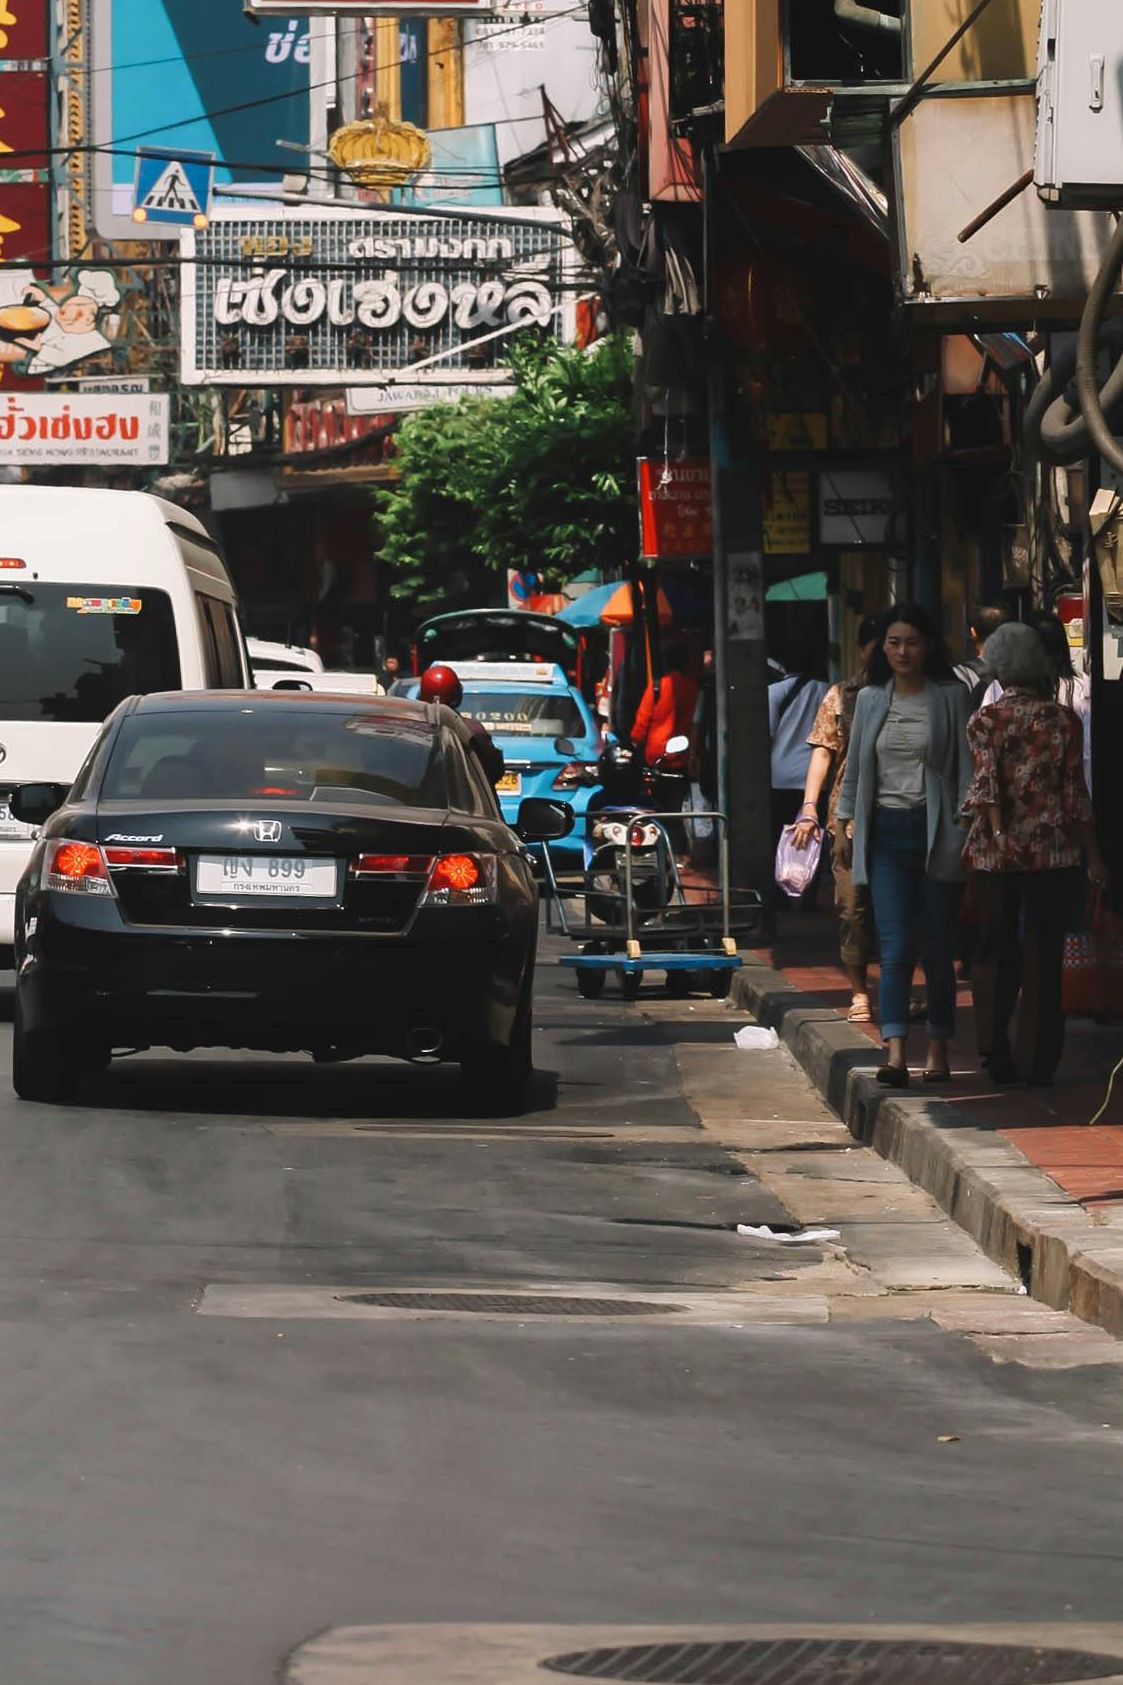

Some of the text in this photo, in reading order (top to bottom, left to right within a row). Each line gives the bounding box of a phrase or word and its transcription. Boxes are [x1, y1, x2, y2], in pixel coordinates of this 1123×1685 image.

[77, 447, 139, 458] RESTAURANT
[104, 833, 163, 843] Accord
[268, 857, 306, 879] 899
